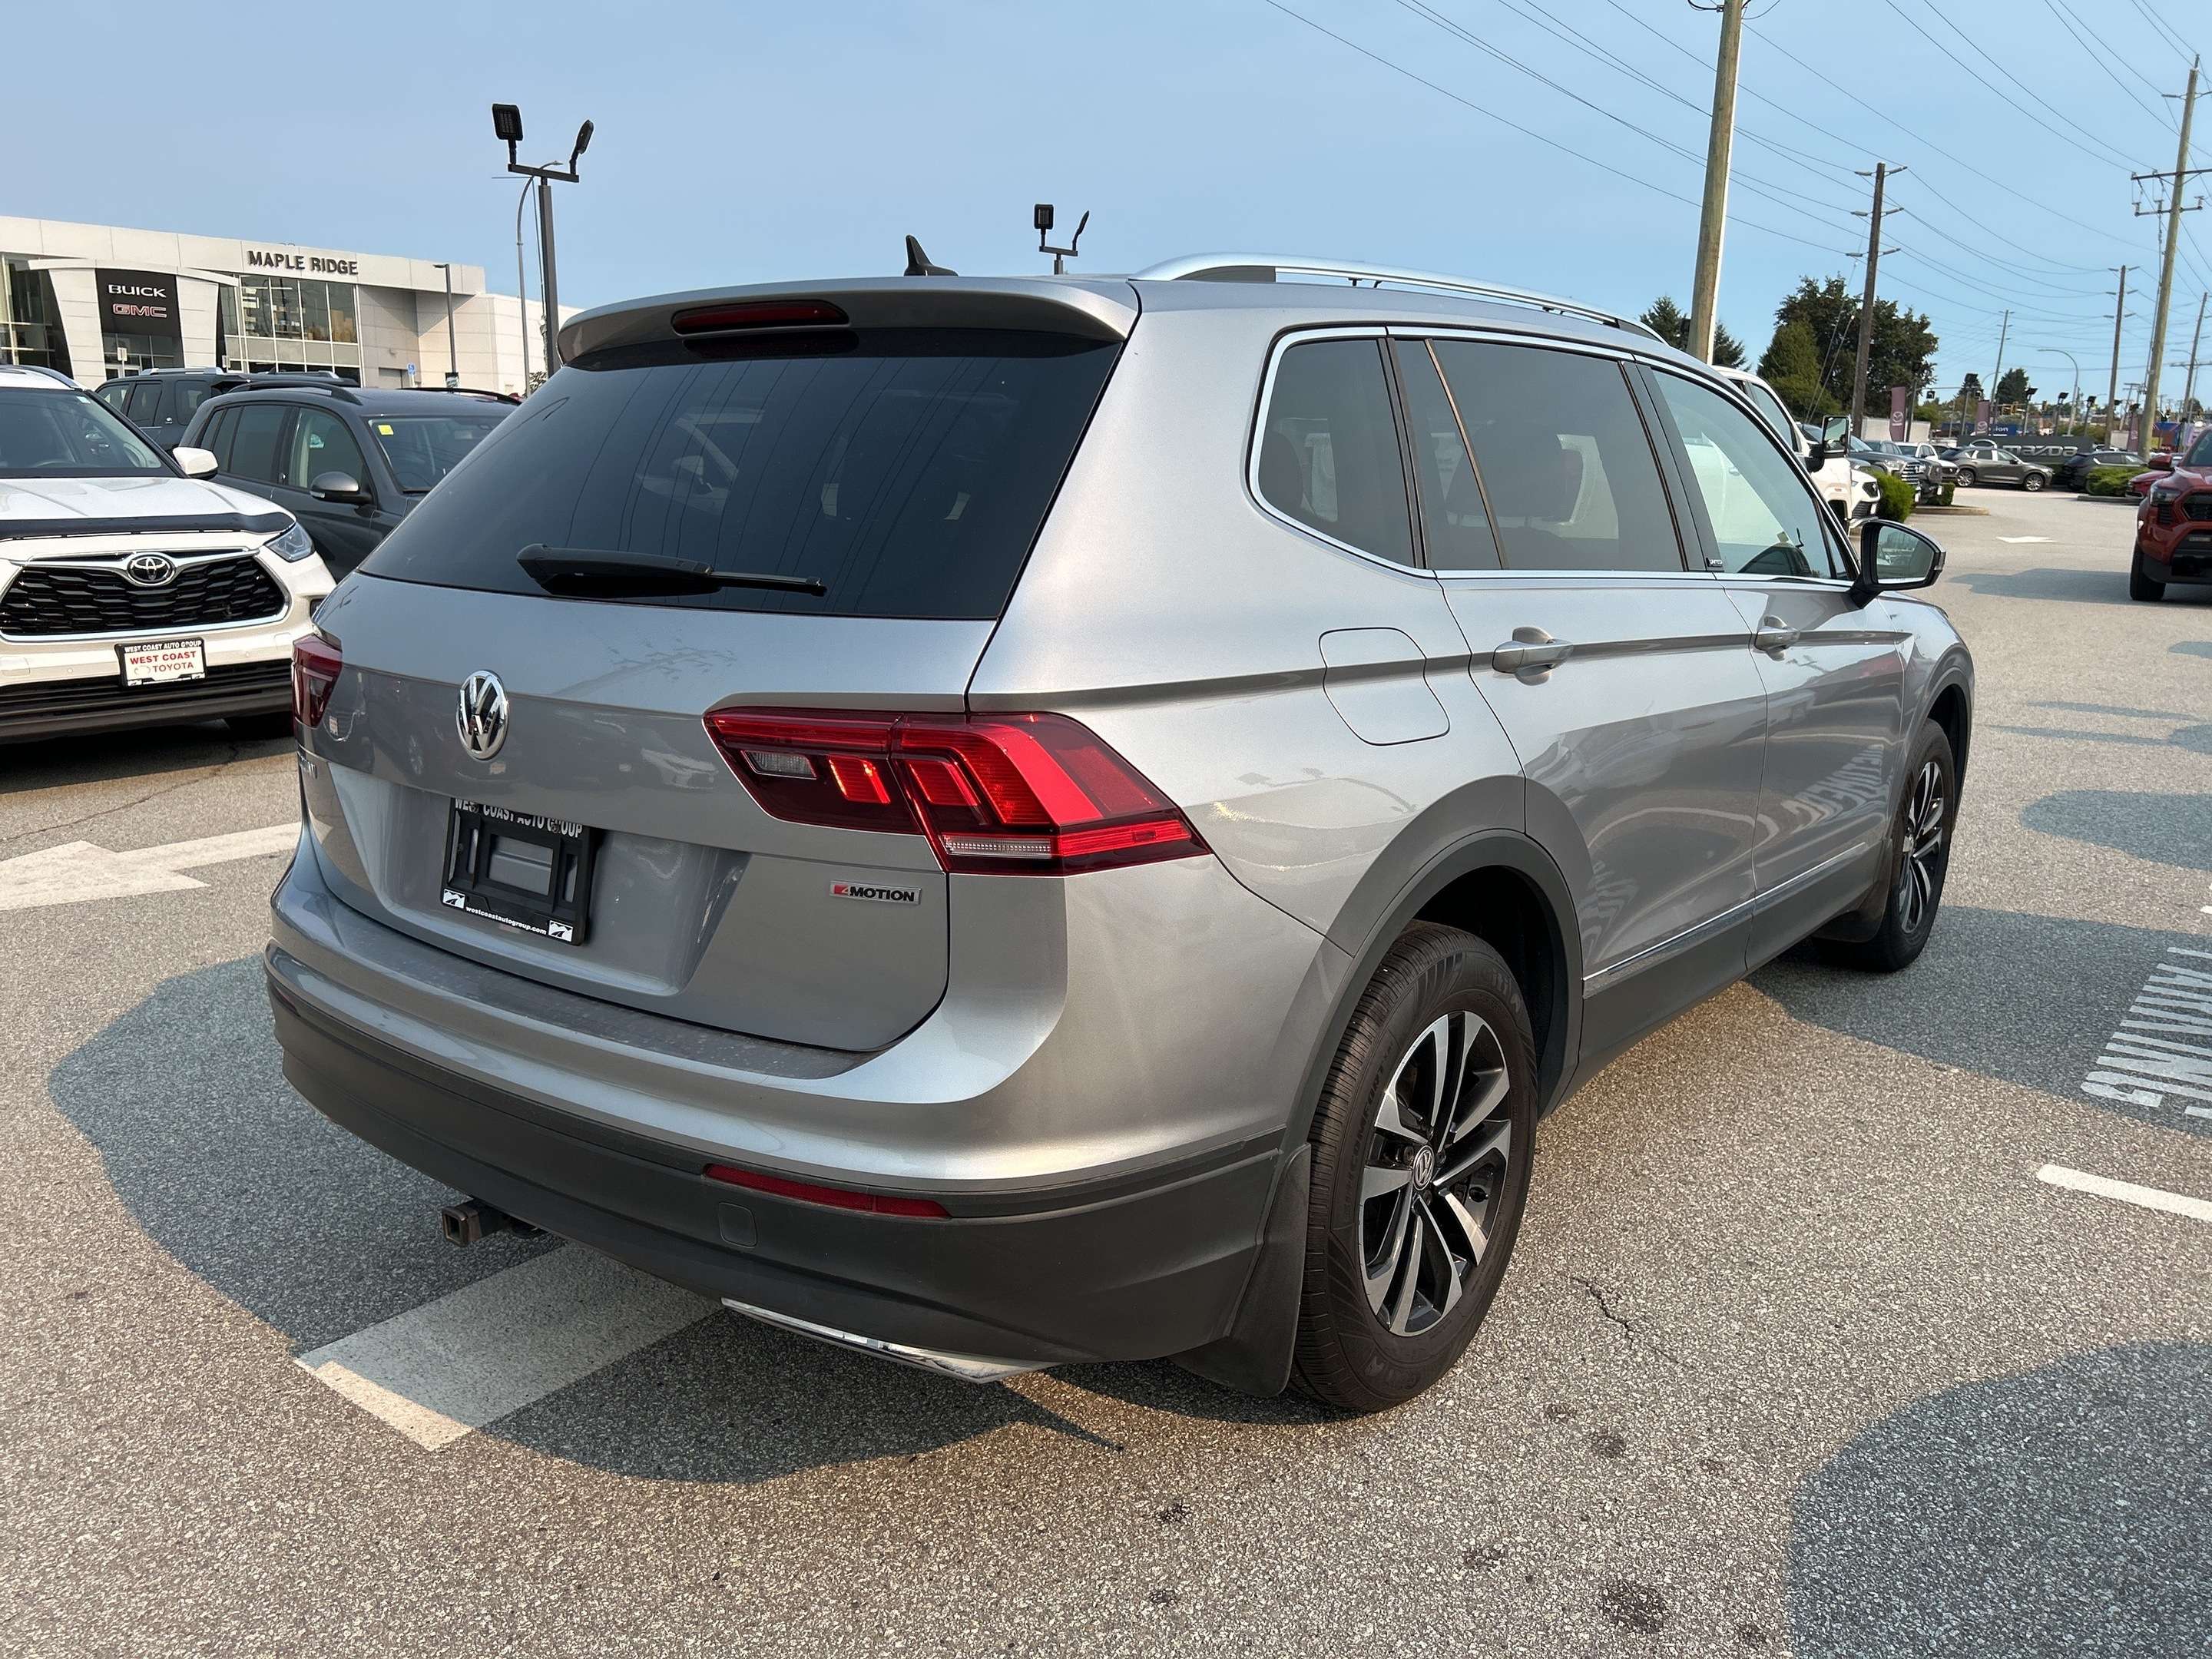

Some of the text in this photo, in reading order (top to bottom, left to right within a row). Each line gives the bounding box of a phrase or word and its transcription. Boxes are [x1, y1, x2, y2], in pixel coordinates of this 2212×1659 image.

[247, 250, 359, 275] MAPLE RIDGE
[108, 284, 167, 298] BUICK
[113, 303, 167, 318] GMC
[124, 645, 142, 654] WEST
[142, 643, 163, 652] COAST
[164, 641, 180, 650] AUTO
[130, 651, 197, 665] WEST COAST
[152, 661, 194, 673] TOYOTA
[455, 797, 478, 813] WES
[465, 906, 547, 935] westcoastautogroup.com
